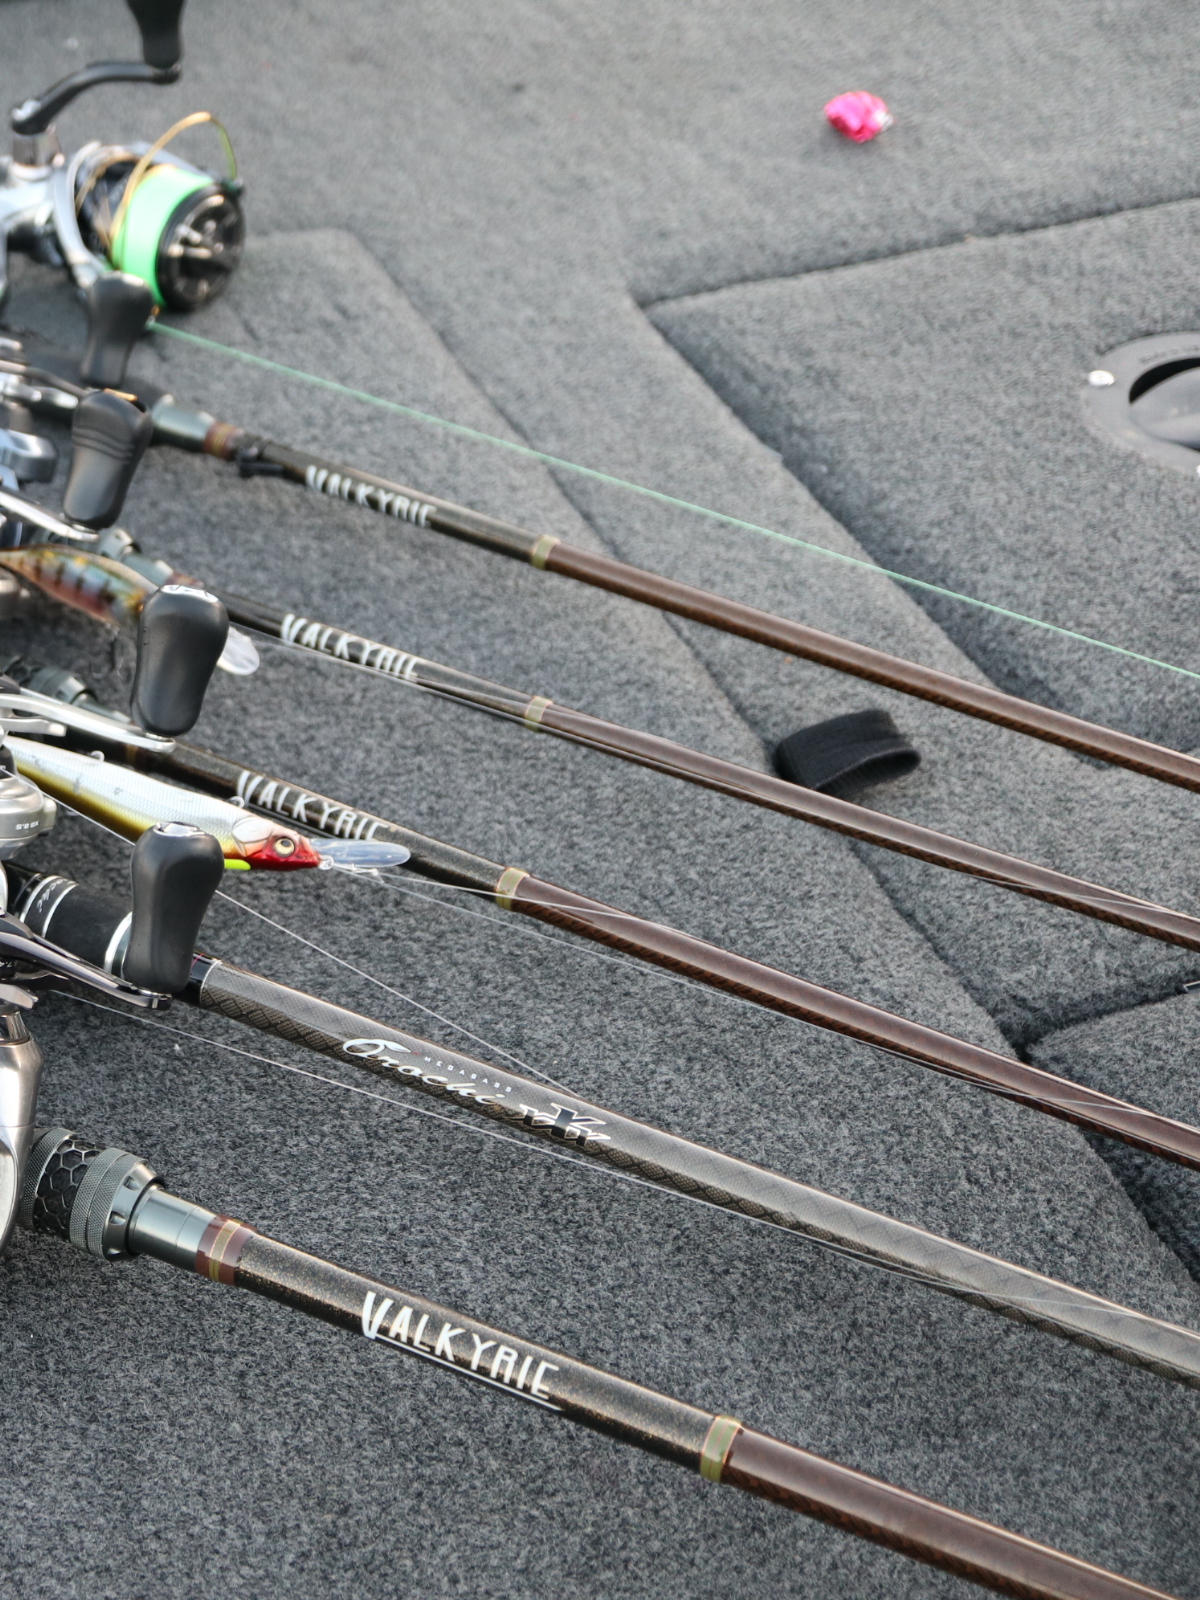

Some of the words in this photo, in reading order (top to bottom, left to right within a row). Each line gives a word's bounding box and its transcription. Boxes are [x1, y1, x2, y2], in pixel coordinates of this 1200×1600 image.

[306, 464, 437, 528] VALKYRIE
[281, 613, 418, 684] VALKYRIE
[342, 1038, 505, 1104] Orochi
[424, 1056, 513, 1093] MEGABASS
[362, 1291, 560, 1400] VALKYRIE
